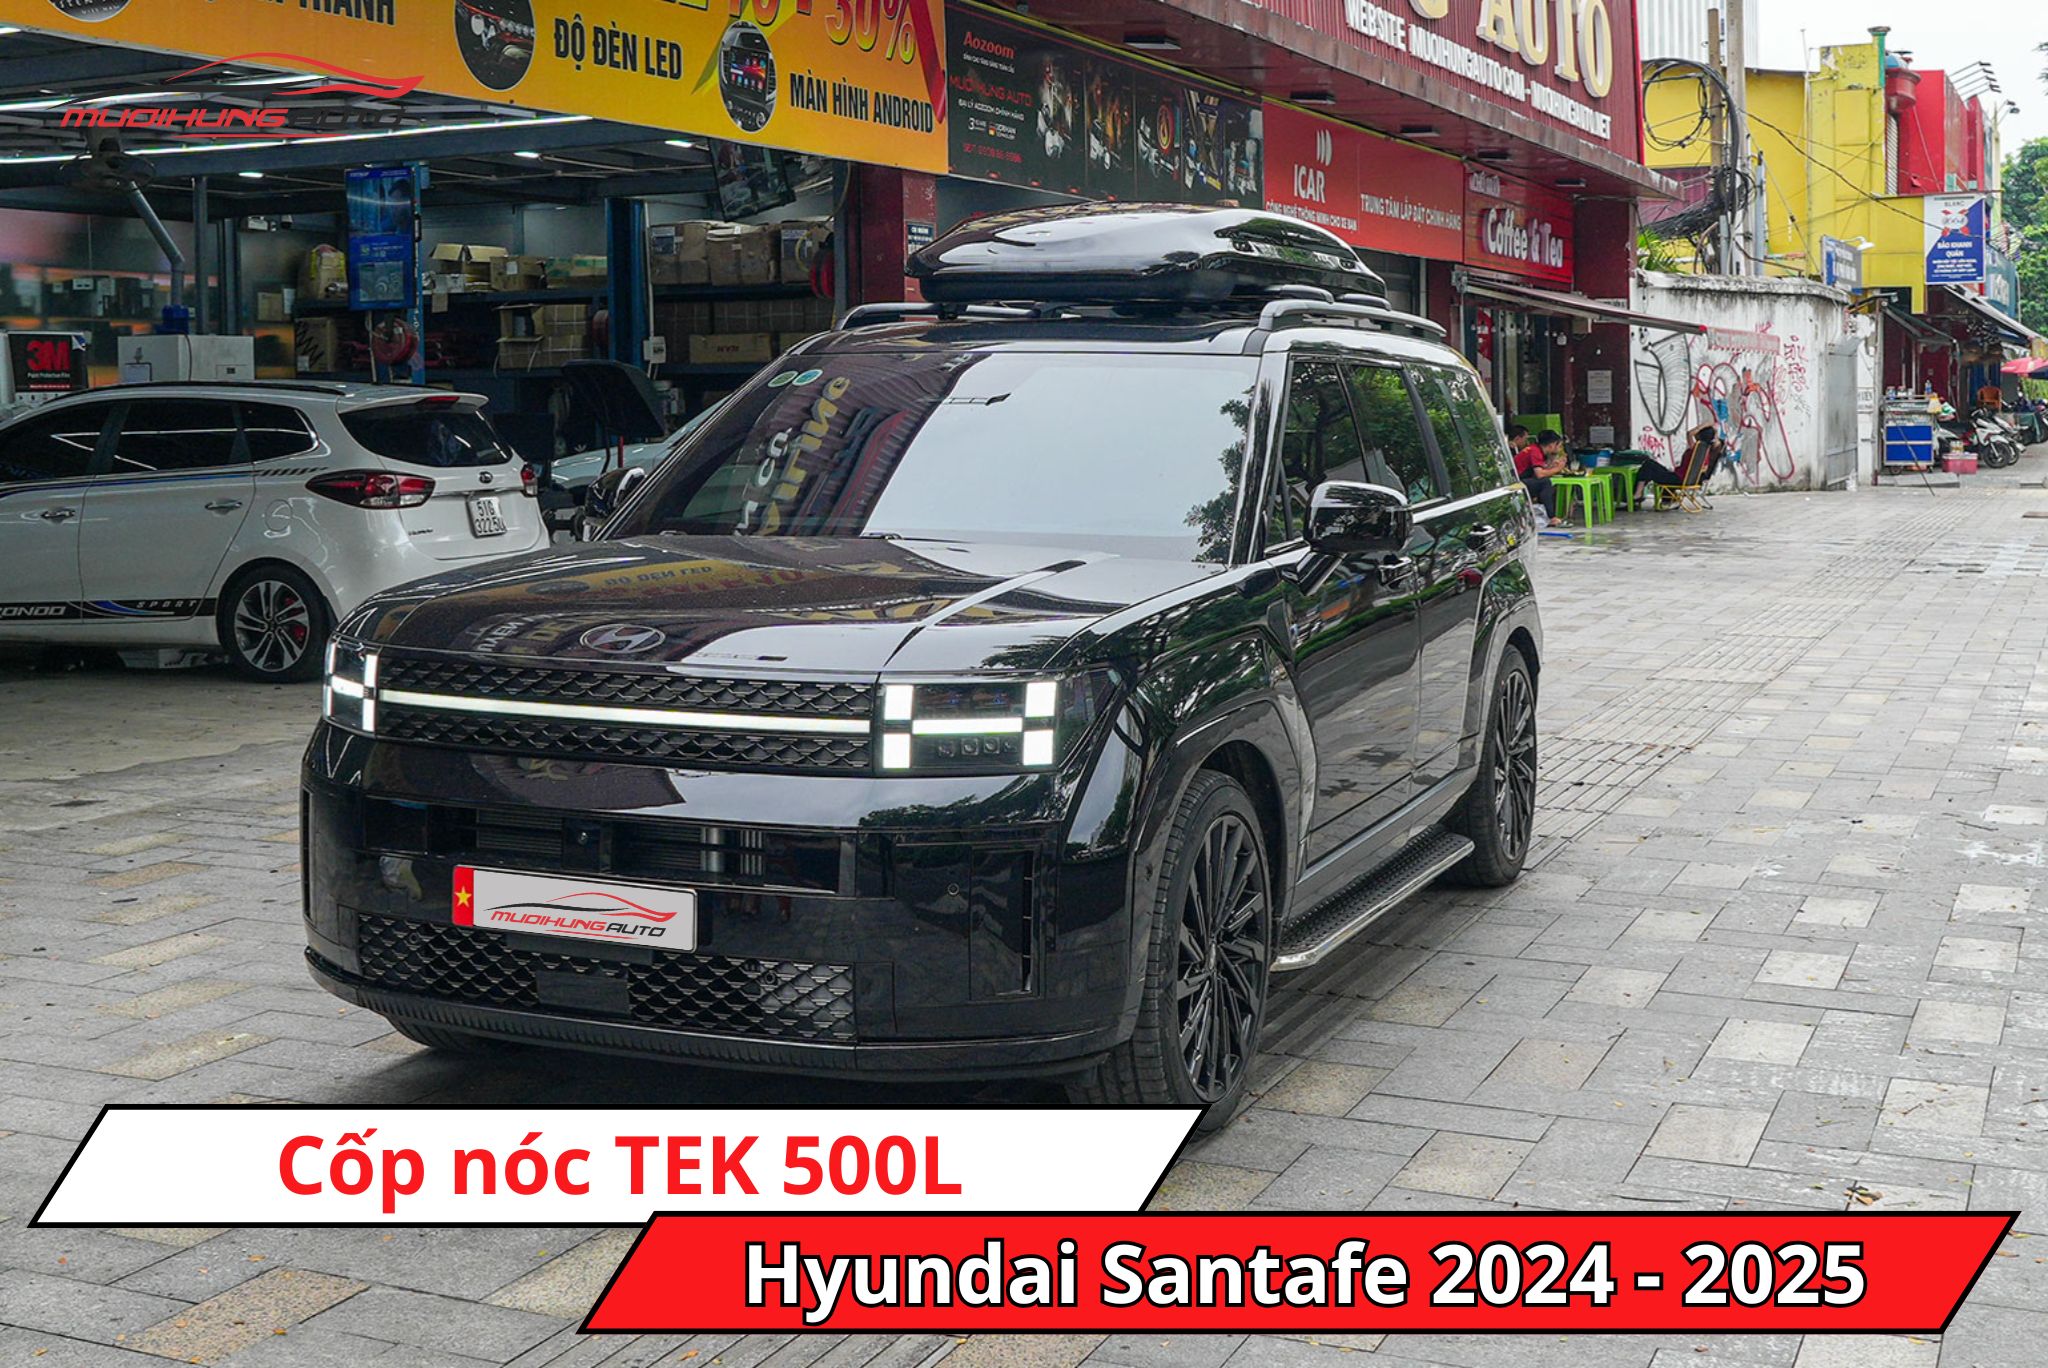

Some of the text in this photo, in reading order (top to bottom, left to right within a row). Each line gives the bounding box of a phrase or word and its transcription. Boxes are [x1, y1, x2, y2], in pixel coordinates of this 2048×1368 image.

[963, 31, 1015, 59] Aozoom
[1345, 0, 1407, 52] WEBSITE
[554, 13, 682, 80] ĐỘ ĐÈN LED
[790, 69, 933, 133] MÀN HÌNH ANDROID
[1293, 164, 1326, 203] ICAR
[1361, 193, 1384, 216] TRUNG
[1385, 196, 1400, 219] TÂM
[1486, 208, 1563, 268] Coffee & Tea
[27, 340, 71, 371] 3M
[0, 600, 197, 618] ONDO SPORT
